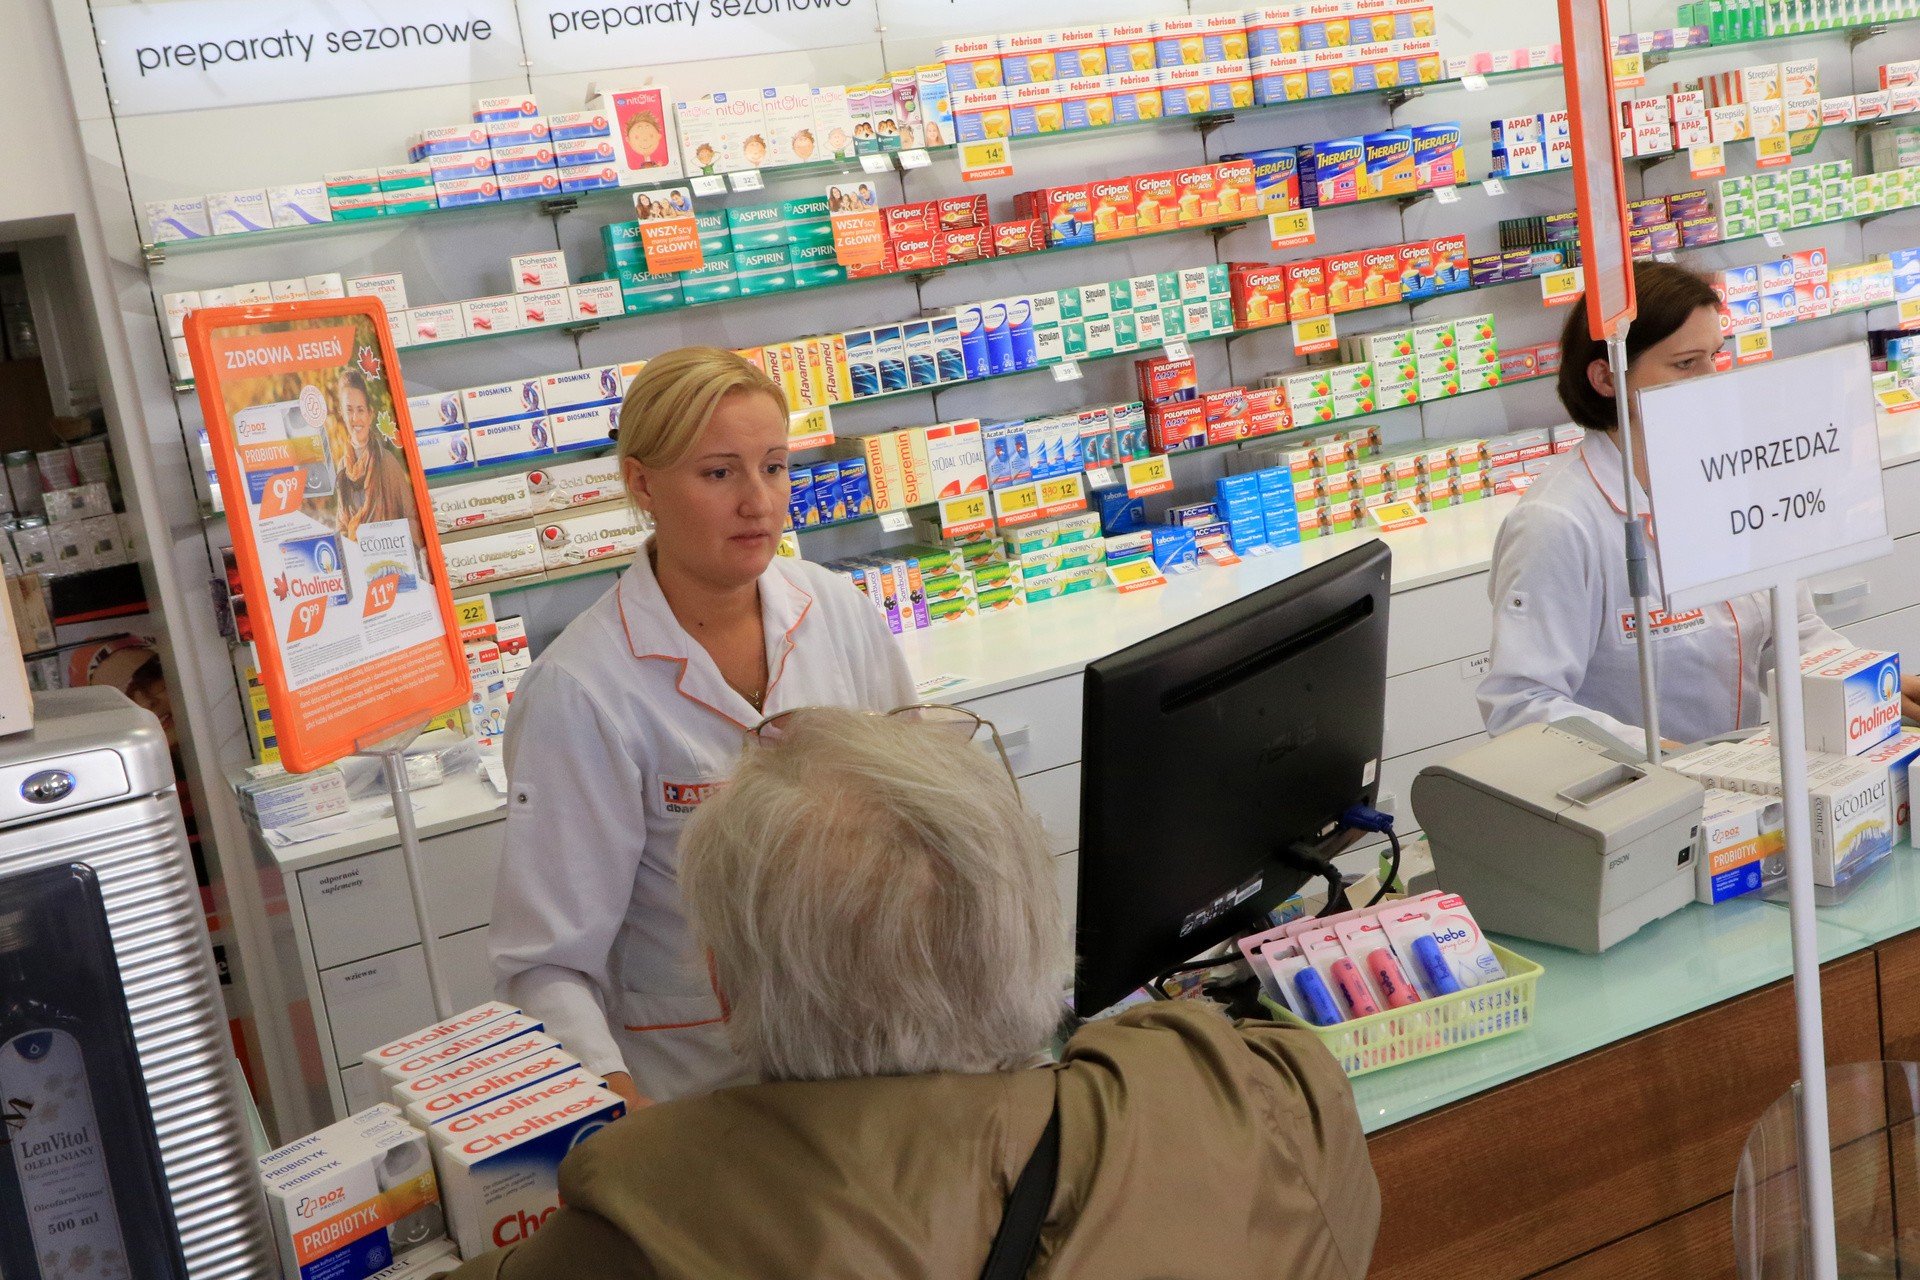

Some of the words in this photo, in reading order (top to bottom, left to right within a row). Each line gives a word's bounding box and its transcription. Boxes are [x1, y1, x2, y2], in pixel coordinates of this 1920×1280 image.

[549, 0, 700, 40] preparaty
[710, 0, 851, 18] sezon
[1207, 17, 1237, 28] Febrisan
[1062, 30, 1094, 42] Febrisan
[1113, 26, 1143, 37] Febrisan
[136, 29, 314, 77] preparaty
[326, 19, 493, 54] sezonowe
[954, 41, 988, 54] Febrisan
[1011, 35, 1043, 47] Febrisan
[1402, 40, 1431, 51] Febrisan
[1784, 63, 1816, 76] Strepsils
[1120, 74, 1150, 86] Febrisan
[964, 92, 997, 104] Febrisan
[1018, 85, 1050, 98] Febrisan
[1677, 93, 1697, 104] APAP
[1635, 99, 1658, 111] APAP
[1714, 108, 1745, 121] Strepsils
[1508, 118, 1533, 130] APAP
[1413, 131, 1458, 153] THERAFLU
[1366, 140, 1410, 161] THERAFLU
[1513, 146, 1537, 158] APAP
[1316, 147, 1362, 170] THERAFLU
[1254, 157, 1294, 178] HERAFLU
[1139, 177, 1172, 191] Gripex
[1179, 172, 1212, 186] Gripex
[1053, 190, 1087, 204] Gripex
[1096, 183, 1129, 197] Gripex
[234, 192, 262, 204] Acard
[173, 201, 203, 213] Acard
[792, 202, 829, 215] ASPIRIN
[892, 208, 922, 219] Gripex
[738, 209, 778, 223] ASPIRIN
[1436, 239, 1464, 252] Gripex
[519, 255, 557, 266] Diohespan
[745, 252, 784, 267] ASPIRIN
[1331, 258, 1359, 272] Gripex
[1366, 253, 1395, 267] Gripex
[355, 278, 395, 289] Diohespan
[1185, 271, 1206, 282] Sinulan
[1249, 274, 1280, 287] Gripex
[1763, 276, 1794, 290] Cholinex
[576, 284, 613, 296] Diohespan
[1085, 288, 1106, 300] Sinulan
[1728, 283, 1758, 297] Cholinex
[469, 299, 508, 311] Diohespan
[1034, 296, 1054, 308] Sinulan
[1765, 307, 1796, 321] Cholinex
[225, 349, 293, 370] ZDROWA
[296, 335, 342, 362] JESIEŃ
[1153, 360, 1192, 373] POLOPIRYNA
[558, 373, 591, 385] DIOSMINEX
[478, 386, 513, 398] DIOSMINEX
[1163, 408, 1202, 420] POLOPIRYNA
[487, 424, 521, 436] DIOSMINEX
[245, 445, 289, 463] PROBIOTYK
[1700, 423, 1840, 484] WYPRZEDAŻ
[867, 439, 888, 509] Supremin
[898, 433, 918, 504] Supremin
[440, 499, 467, 513] Gold
[467, 491, 514, 509] Omega
[1730, 504, 1764, 536] DO
[1771, 488, 1826, 523] -70%
[360, 533, 405, 554] ecomer
[573, 532, 598, 545] Gold
[291, 575, 344, 598] Cholinex
[1849, 701, 1900, 742] Cholinex
[1834, 779, 1887, 823] ecomer
[1723, 827, 1740, 837] DOZ
[1713, 844, 1757, 869] PROBIOTYK
[1432, 927, 1466, 944] bebe
[379, 1007, 502, 1059] Cholinex
[399, 1020, 525, 1073] Cholinex
[410, 1039, 542, 1092] Cholinex
[425, 1057, 562, 1112] Cholinex
[447, 1076, 587, 1133] Cholinex
[462, 1095, 605, 1155] Cholinex
[20, 1126, 90, 1159] LenVitol
[261, 1134, 322, 1167] PROBIOTYK
[265, 1149, 328, 1181] PROBIOTYK
[278, 1159, 341, 1193] PROBIOTYK
[318, 1186, 345, 1207] DOZ
[47, 1217, 76, 1236] 500
[302, 1203, 380, 1256] PROBIOTYK
